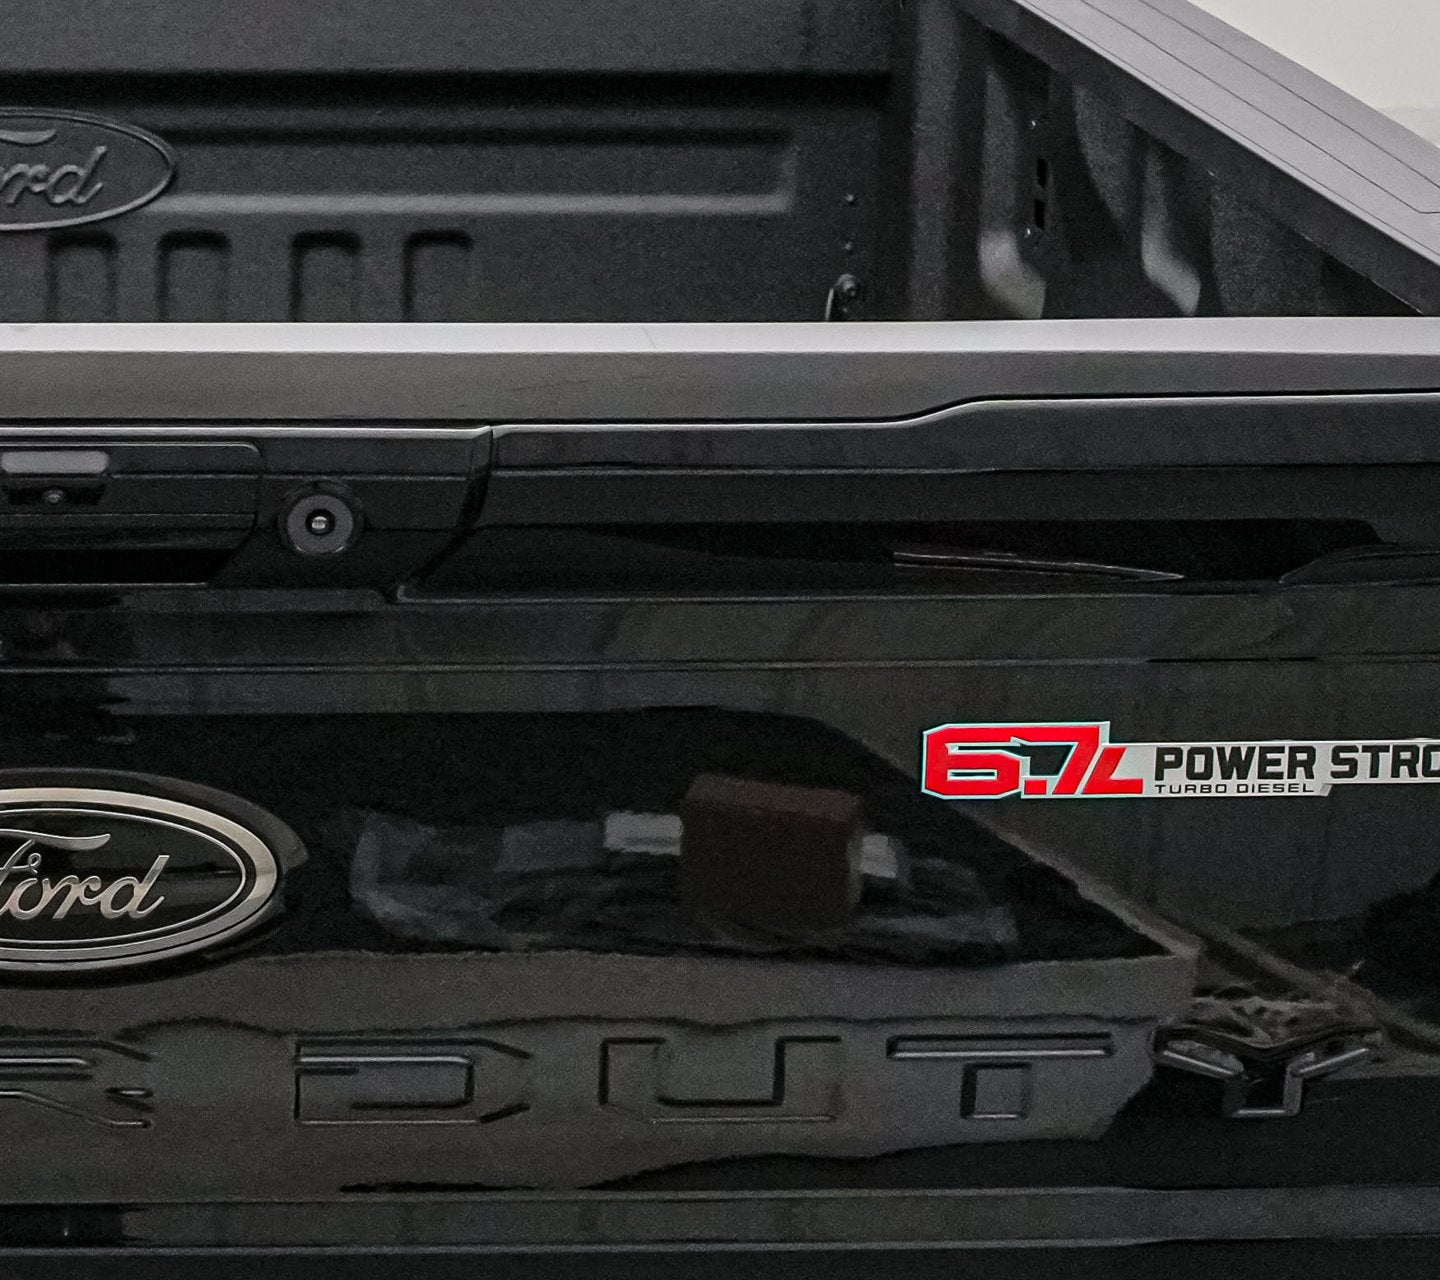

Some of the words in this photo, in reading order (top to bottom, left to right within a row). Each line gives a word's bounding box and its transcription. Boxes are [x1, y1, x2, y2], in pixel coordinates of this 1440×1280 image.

[923, 723, 1143, 798] 6.7L
[1154, 744, 1315, 781] POWER
[1155, 783, 1228, 794] TURBO
[1235, 782, 1314, 794] DIESEL
[293, 1027, 1381, 1125] DUTY
